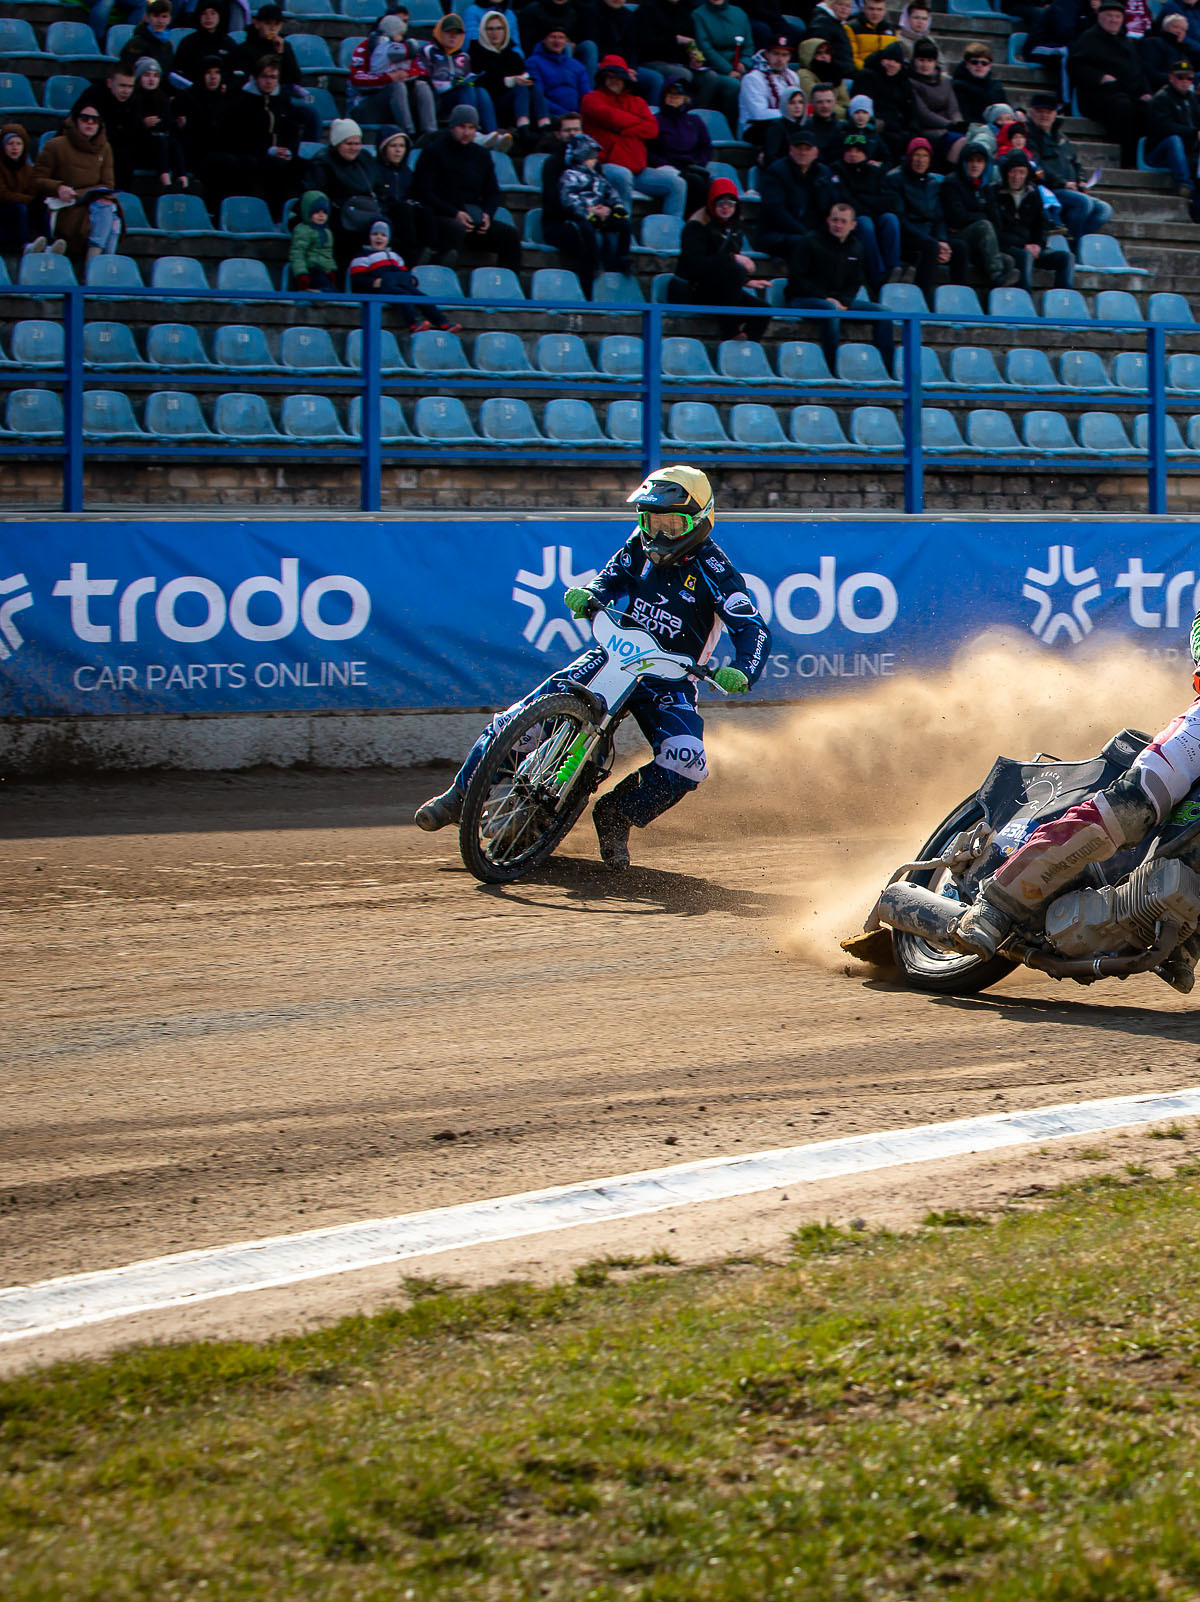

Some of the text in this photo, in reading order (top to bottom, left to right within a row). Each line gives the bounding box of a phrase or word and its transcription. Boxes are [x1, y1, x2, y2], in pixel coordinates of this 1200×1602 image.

[51, 558, 371, 642] trodo
[73, 661, 367, 691] CAR PARTS ONLINE
[796, 653, 895, 678] ONLINE
